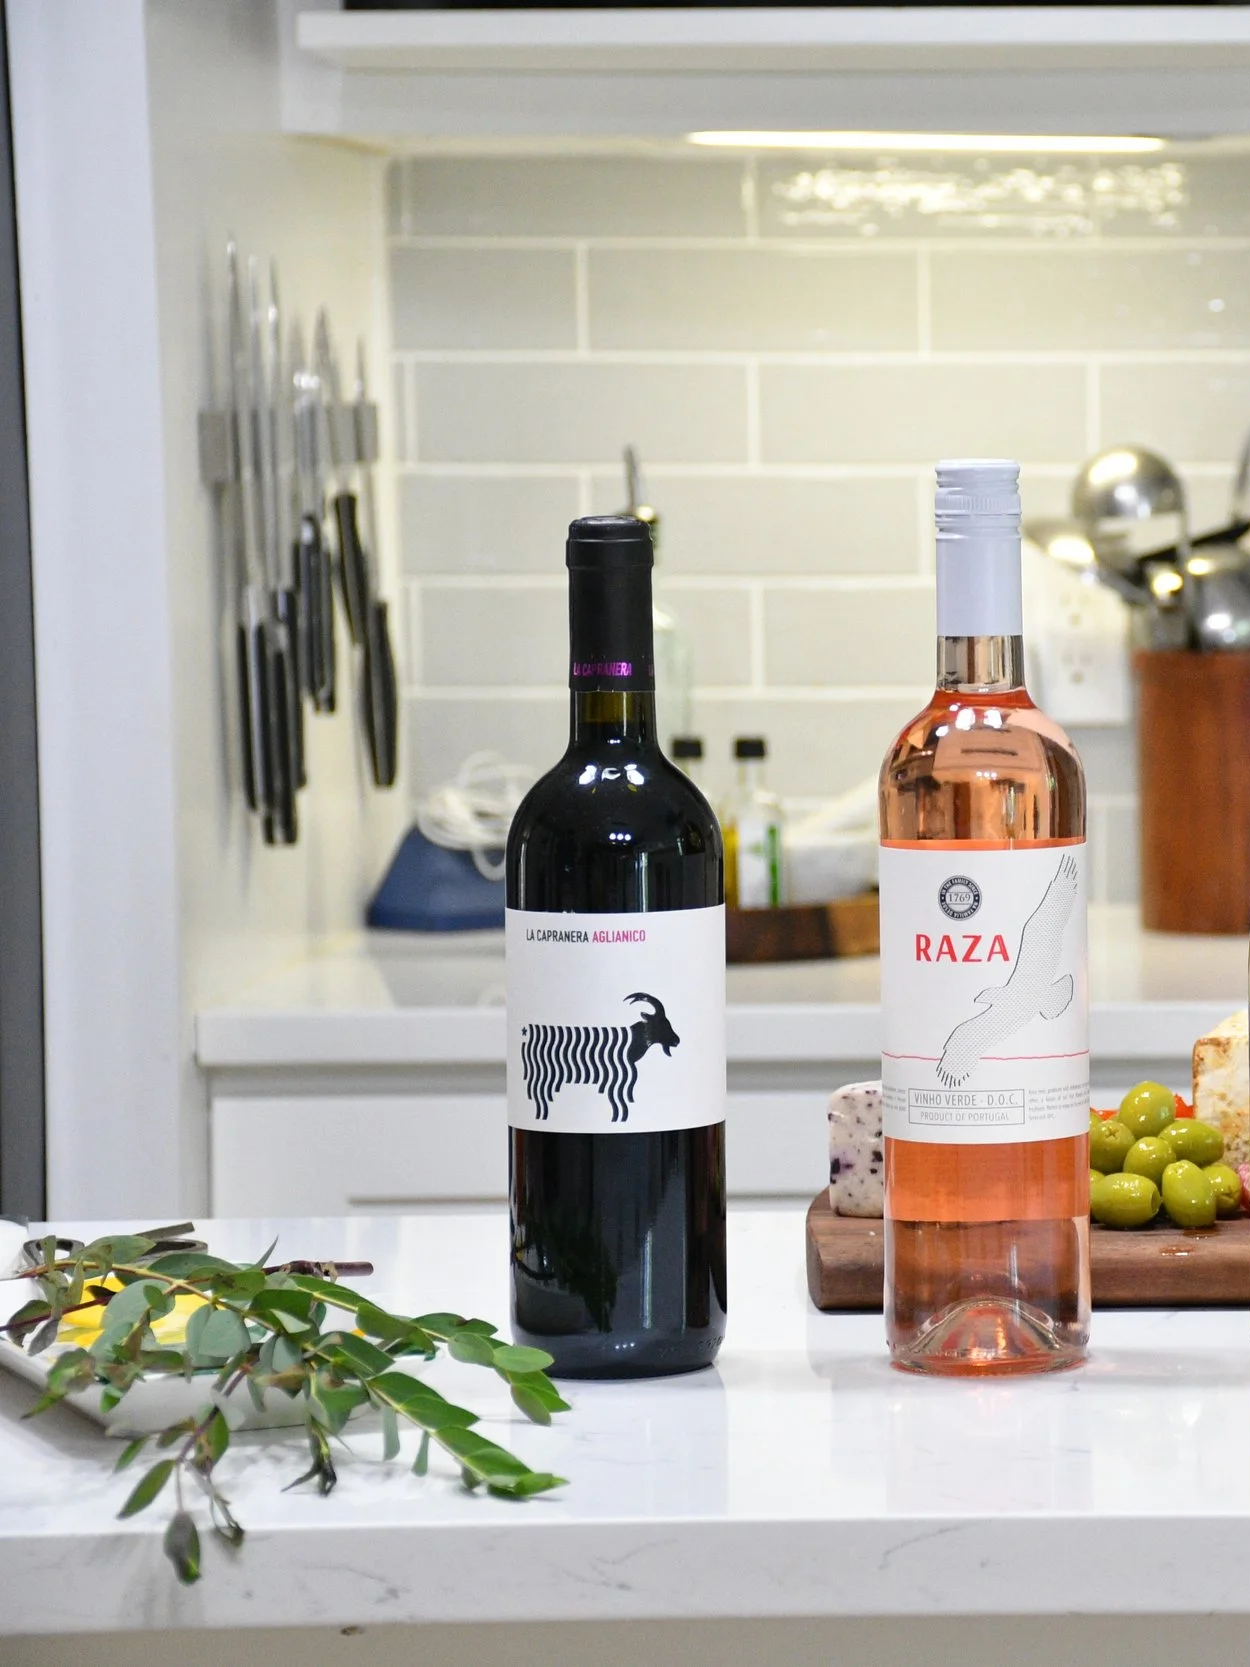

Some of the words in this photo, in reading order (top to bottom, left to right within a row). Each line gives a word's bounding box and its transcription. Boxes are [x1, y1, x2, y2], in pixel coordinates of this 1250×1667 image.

[949, 893, 971, 903] 1769
[526, 929, 535, 941] LA
[536, 929, 589, 943] CAPRANERA
[592, 930, 646, 943] AGLIANICO
[915, 933, 1011, 963] RAZA
[914, 1093, 942, 1105] VINHO
[944, 1094, 977, 1106] VERDE
[987, 1093, 1018, 1106] D.O.C.
[920, 1111, 953, 1121] PRODUCT
[956, 1112, 966, 1121] OF
[968, 1112, 1010, 1121] PORTUGAL
